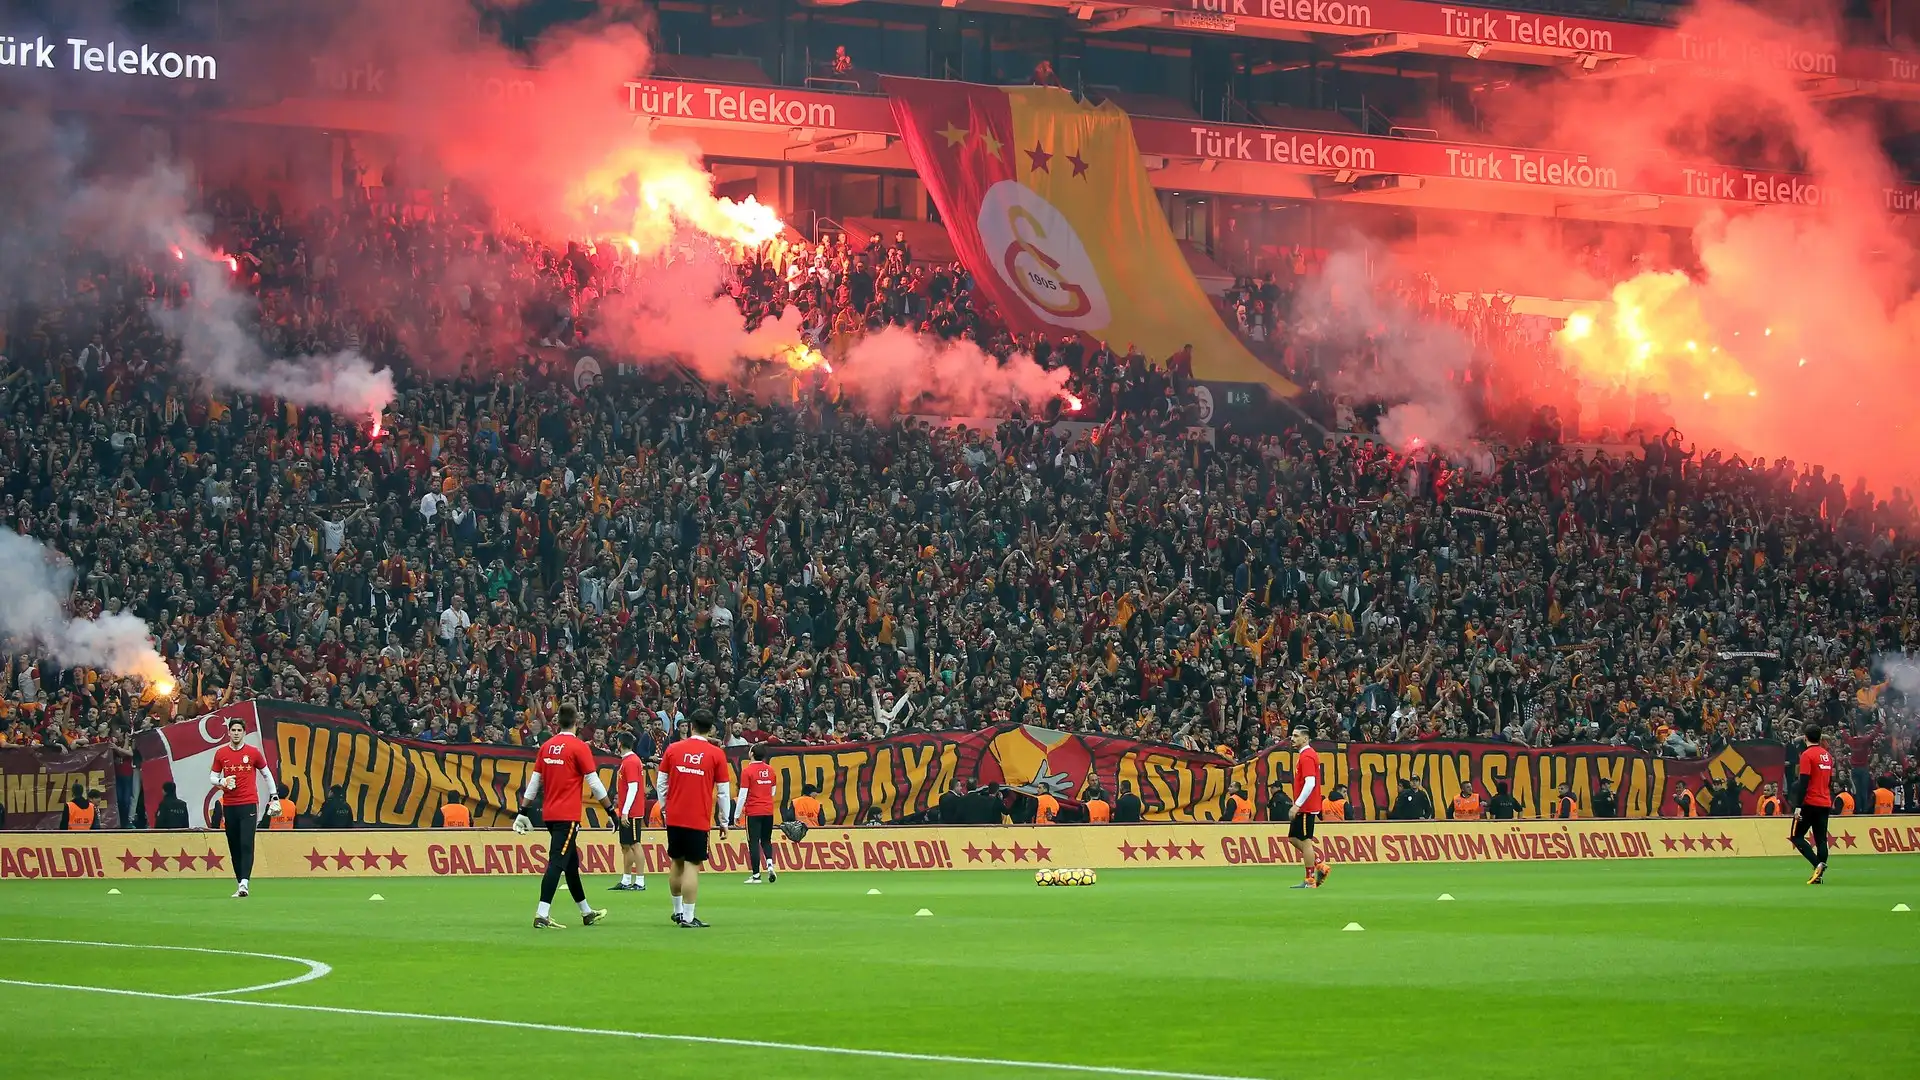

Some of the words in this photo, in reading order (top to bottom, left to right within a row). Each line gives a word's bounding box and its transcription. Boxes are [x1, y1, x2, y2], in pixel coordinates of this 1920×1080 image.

[1441, 8, 1498, 40] Türk
[1506, 14, 1612, 51] Telekom
[0, 36, 56, 68] ürk
[67, 38, 217, 80] Telekom
[624, 81, 693, 116] Türk
[704, 87, 835, 127] Telekom
[1191, 127, 1252, 160] Türk
[1261, 133, 1375, 169] Telekom
[1445, 148, 1502, 180] Türk
[1510, 153, 1617, 188] Telekom
[1681, 168, 1735, 198] Türk
[1028, 271, 1057, 291] 1905
[549, 743, 565, 755] nef
[683, 752, 704, 765] nef
[428, 844, 615, 874] GALATASRAY
[863, 840, 953, 870] AÇILDI!
[1381, 834, 1491, 861] STADYUM
[1490, 826, 1577, 860] MÜZESİ
[1579, 832, 1654, 860] AÇILDI!
[1, 847, 104, 879] AÇILDI!
